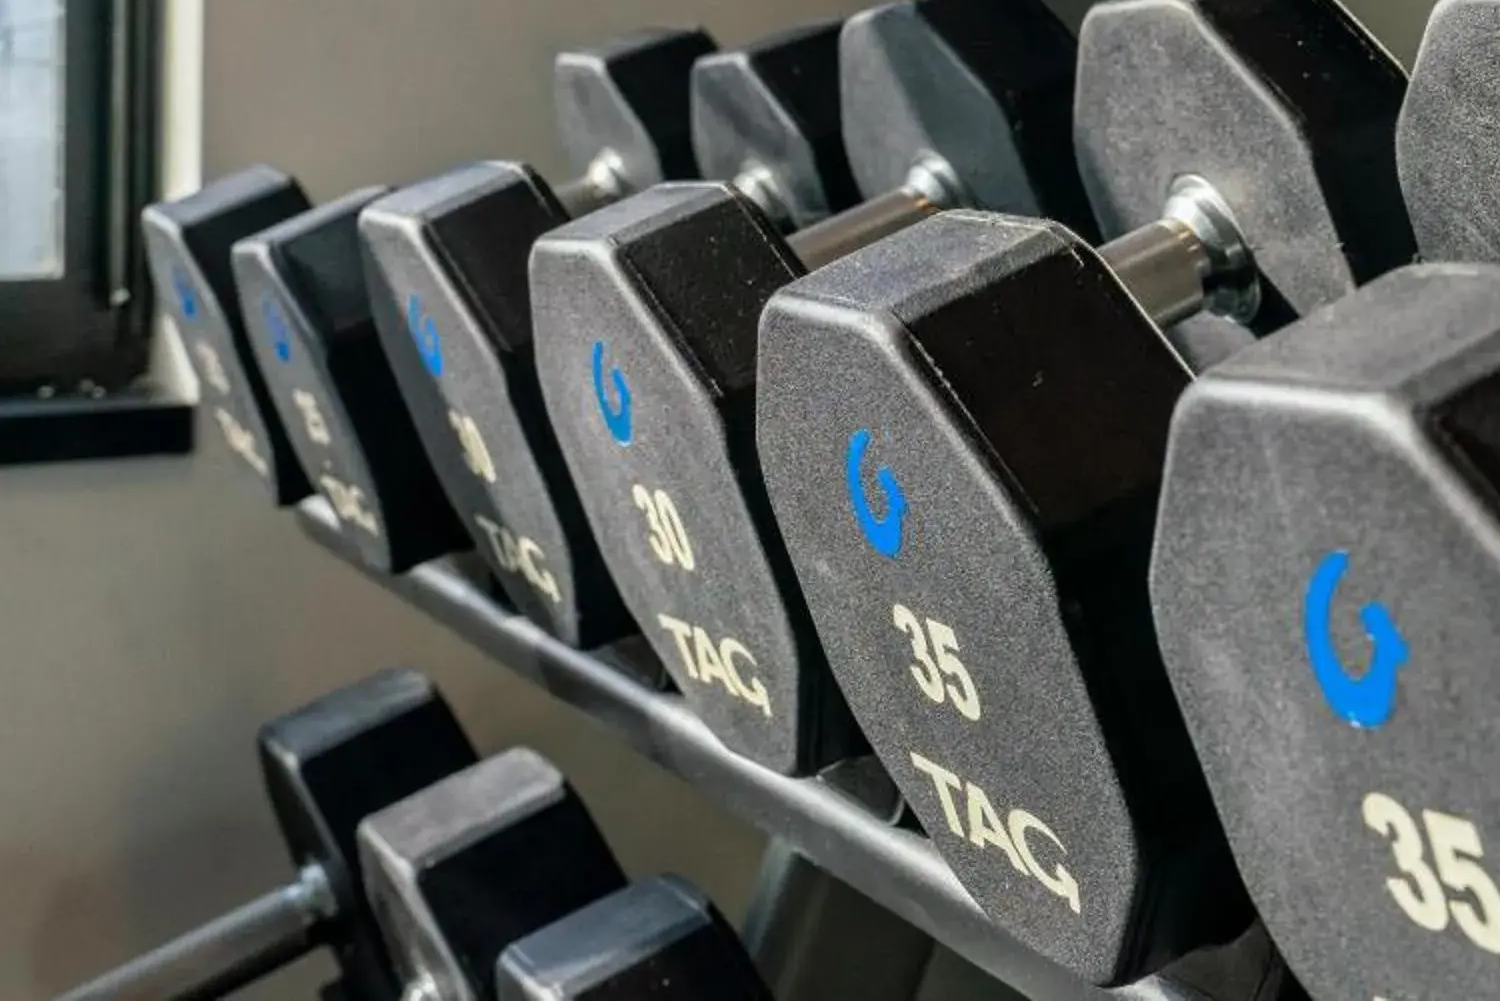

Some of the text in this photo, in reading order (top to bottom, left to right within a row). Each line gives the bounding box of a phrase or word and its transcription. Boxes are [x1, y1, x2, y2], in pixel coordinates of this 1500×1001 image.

[632, 482, 695, 572] 30
[657, 612, 773, 718] TAG
[893, 604, 982, 721] 35
[909, 751, 1082, 915] TAG
